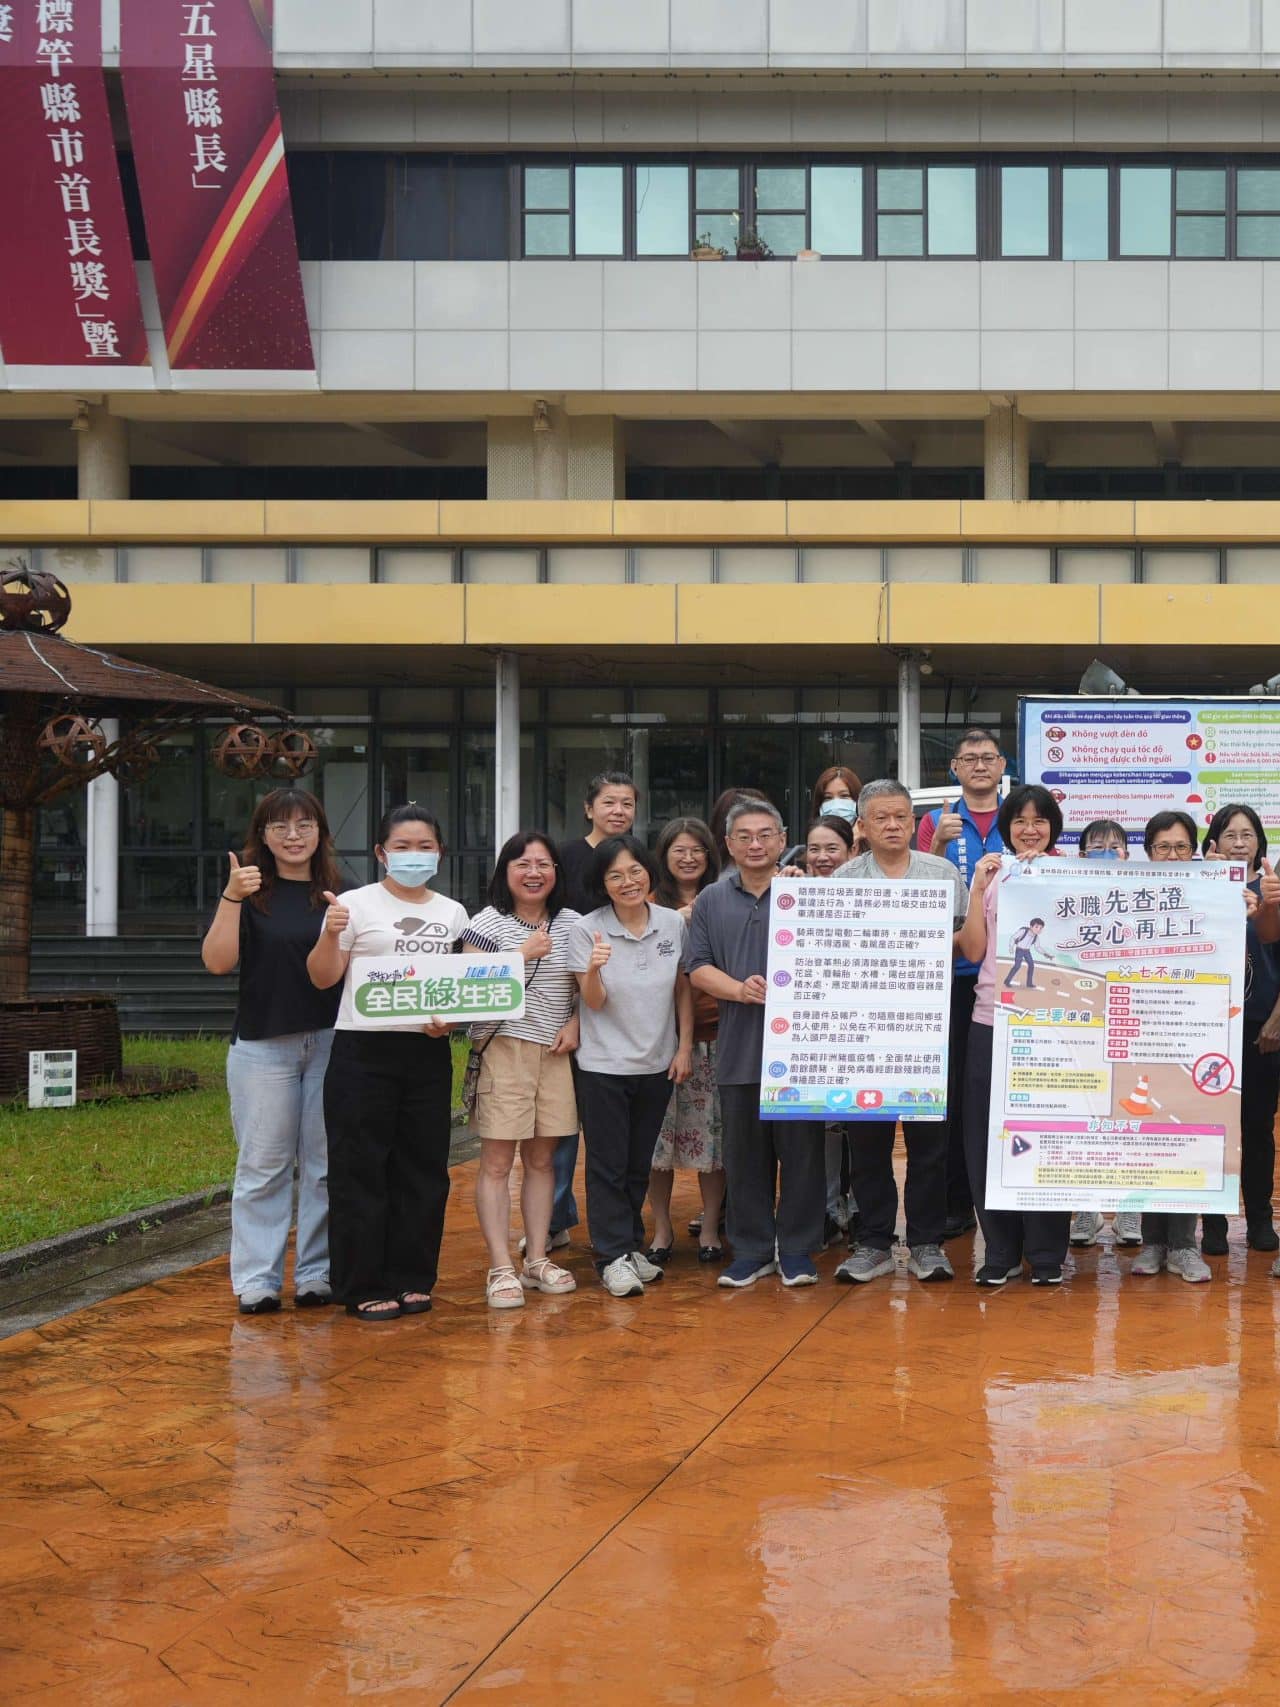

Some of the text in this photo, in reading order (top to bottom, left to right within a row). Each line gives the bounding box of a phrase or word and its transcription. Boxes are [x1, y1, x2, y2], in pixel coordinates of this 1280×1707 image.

[1056, 886, 1190, 918] 求職先查證
[434, 926, 444, 934] R
[1079, 917, 1201, 946] 安心再上工
[394, 939, 449, 955] ROOTS
[1139, 966, 1196, 979] 七不原則
[366, 978, 513, 1012] 全民綠生活
